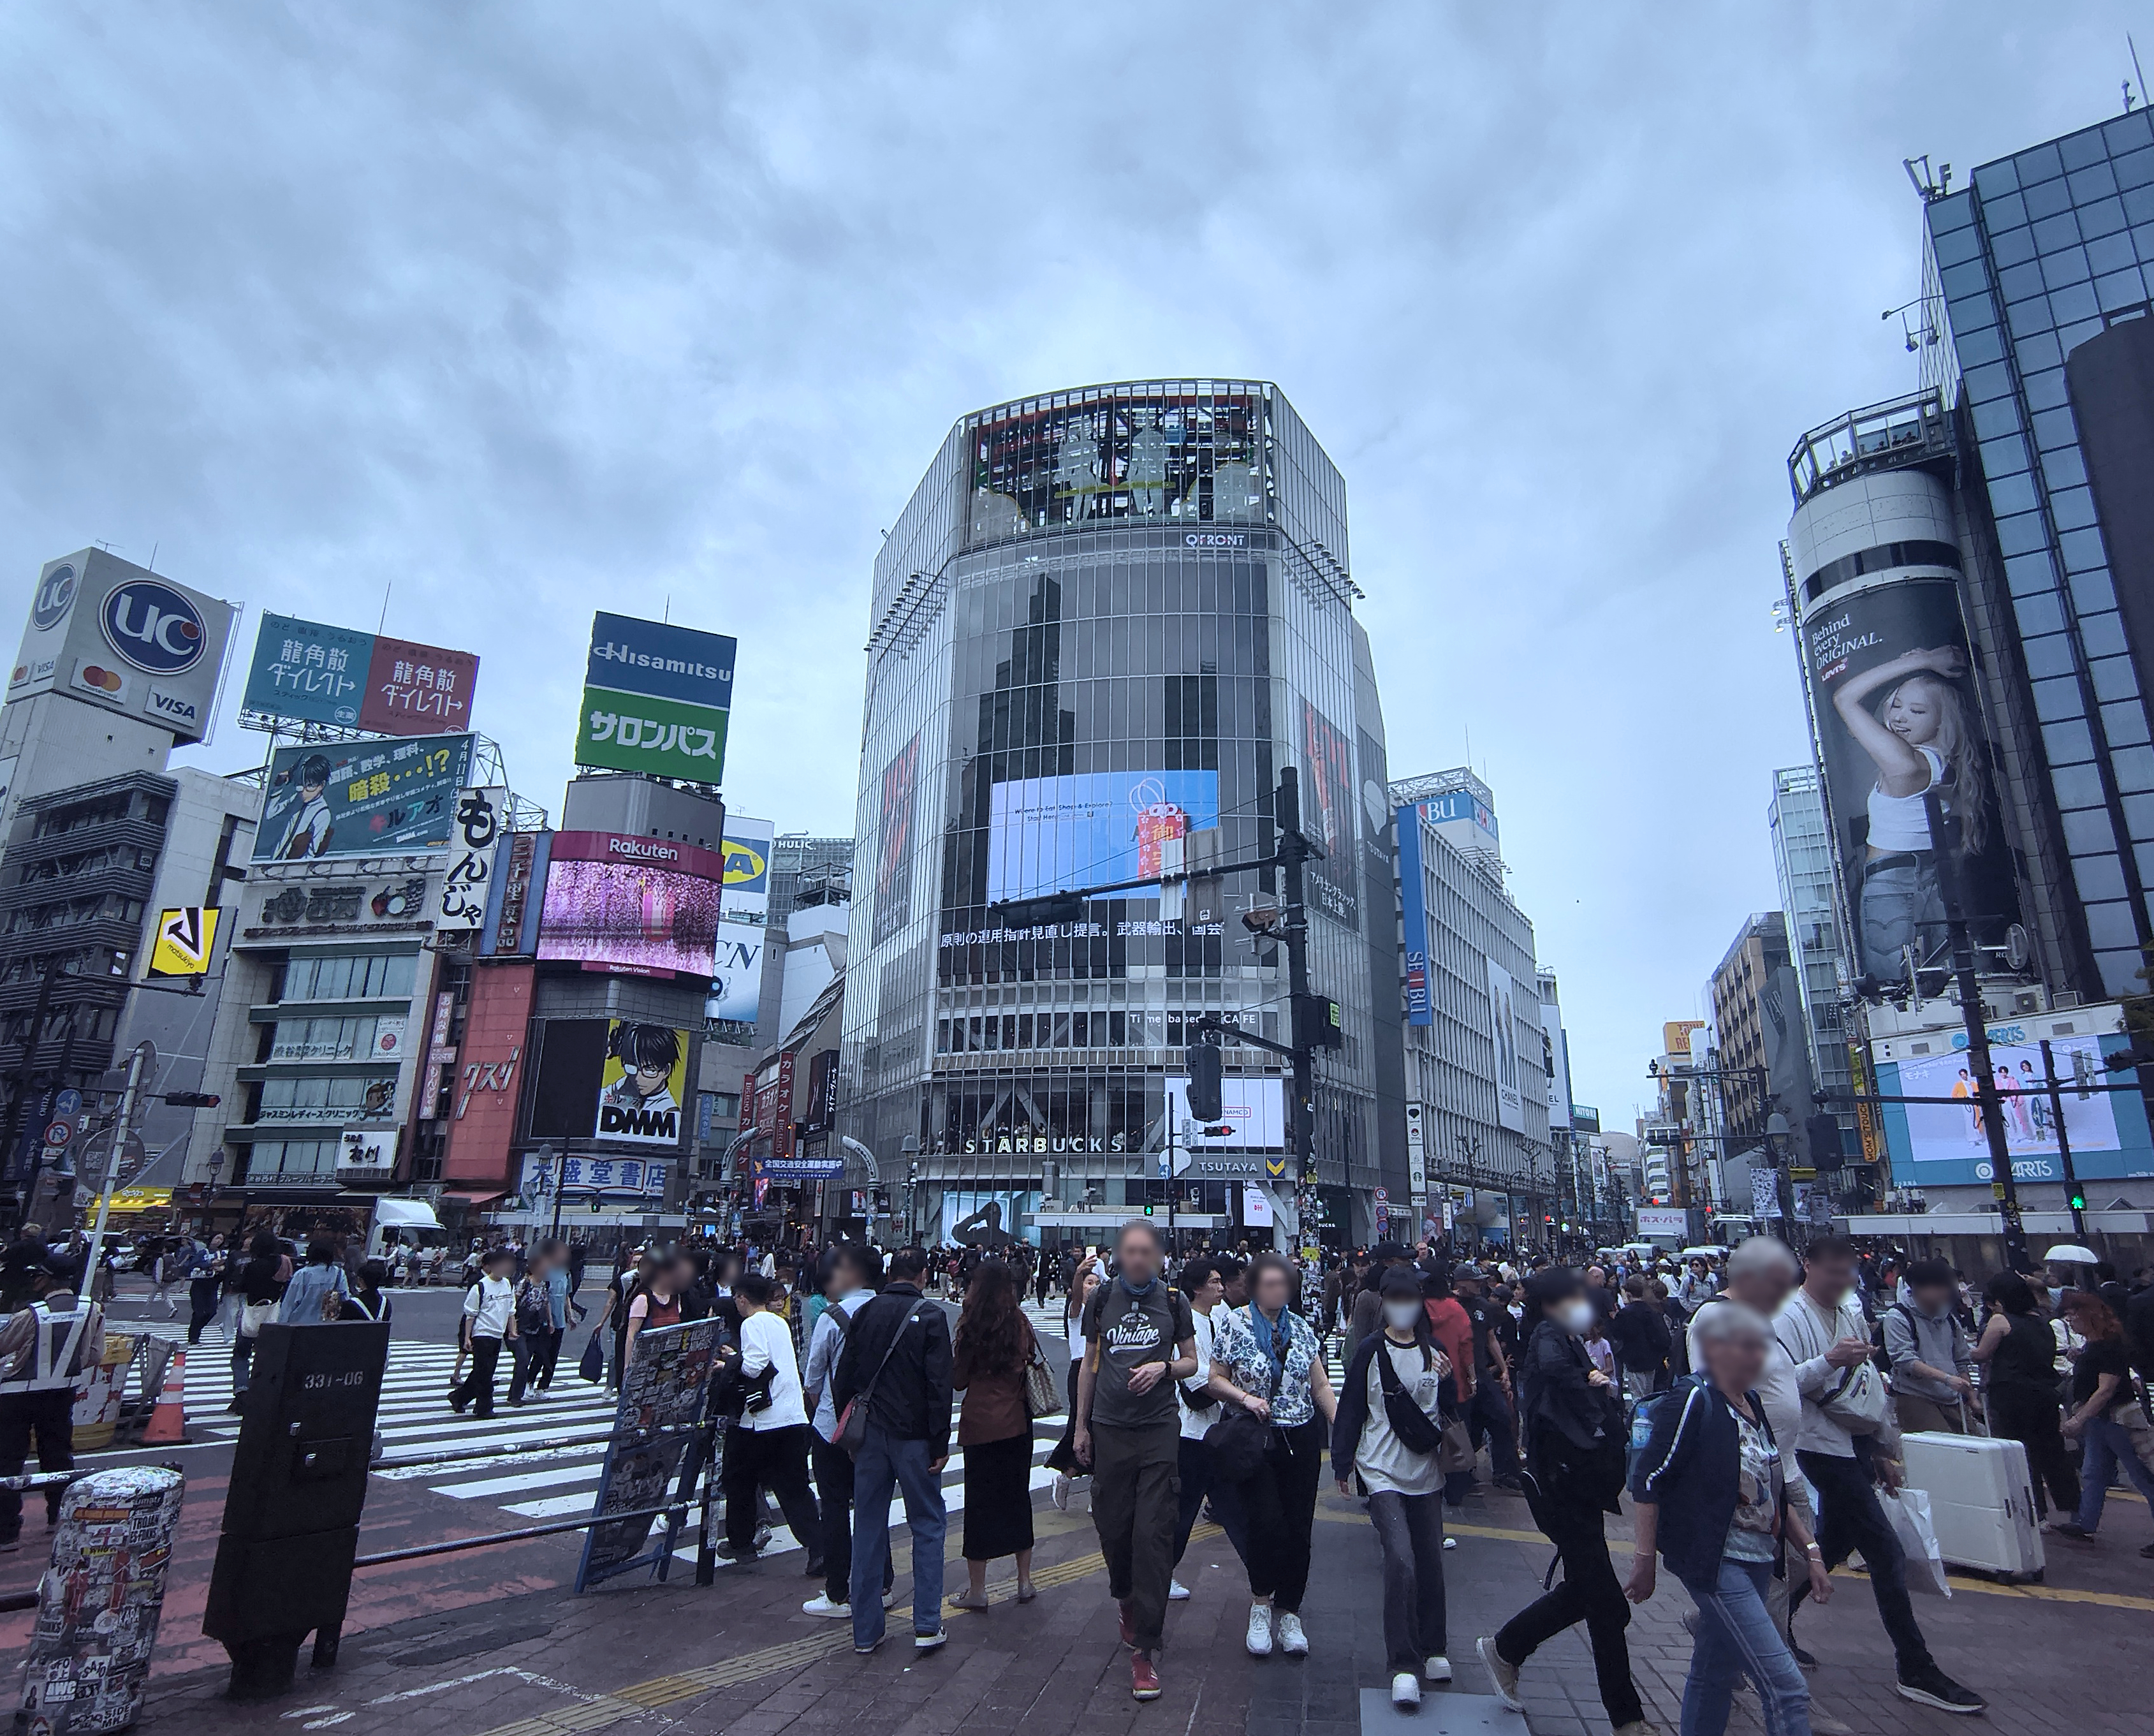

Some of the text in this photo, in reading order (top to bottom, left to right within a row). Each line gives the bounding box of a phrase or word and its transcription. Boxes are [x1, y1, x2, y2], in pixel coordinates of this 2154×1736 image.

[1185, 534, 1245, 548] QFRONT
[38, 577, 73, 612] UC
[115, 593, 196, 656] UC
[1812, 613, 1852, 645] Behind
[281, 638, 349, 672] 龍角散
[593, 641, 732, 682] Hisamitsu
[1814, 633, 1840, 657] every
[1816, 631, 1883, 670] ORIGINAL.
[267, 663, 356, 697] ダイレクト
[393, 659, 457, 693] 龍角散
[152, 691, 196, 720] VISA
[381, 684, 464, 717] ダイレクト
[590, 710, 717, 761] サロンパス
[1422, 798, 1457, 821] BU
[441, 789, 497, 926] もんじゃ
[609, 838, 678, 862] Rakuten
[496, 834, 536, 948] 三千里薬品
[167, 943, 195, 969] matsukiyo
[1407, 951, 1427, 1013] SEIBU
[1129, 1014, 1161, 1024] Time
[1223, 1014, 1256, 1024] CAFE
[777, 1059, 792, 1114] カラオケ
[1501, 1089, 1519, 1106] CHANEL
[599, 1105, 676, 1138] DMM
[1575, 1106, 1597, 1119] NITORI
[965, 1137, 1122, 1154] STARBUCKS
[1859, 1103, 1874, 1161] MOM'S TOUCH
[532, 1159, 666, 1188] 大盛堂書店
[1199, 1162, 1258, 1172] TSUTAYA
[1106, 1323, 1159, 1346] Vintage
